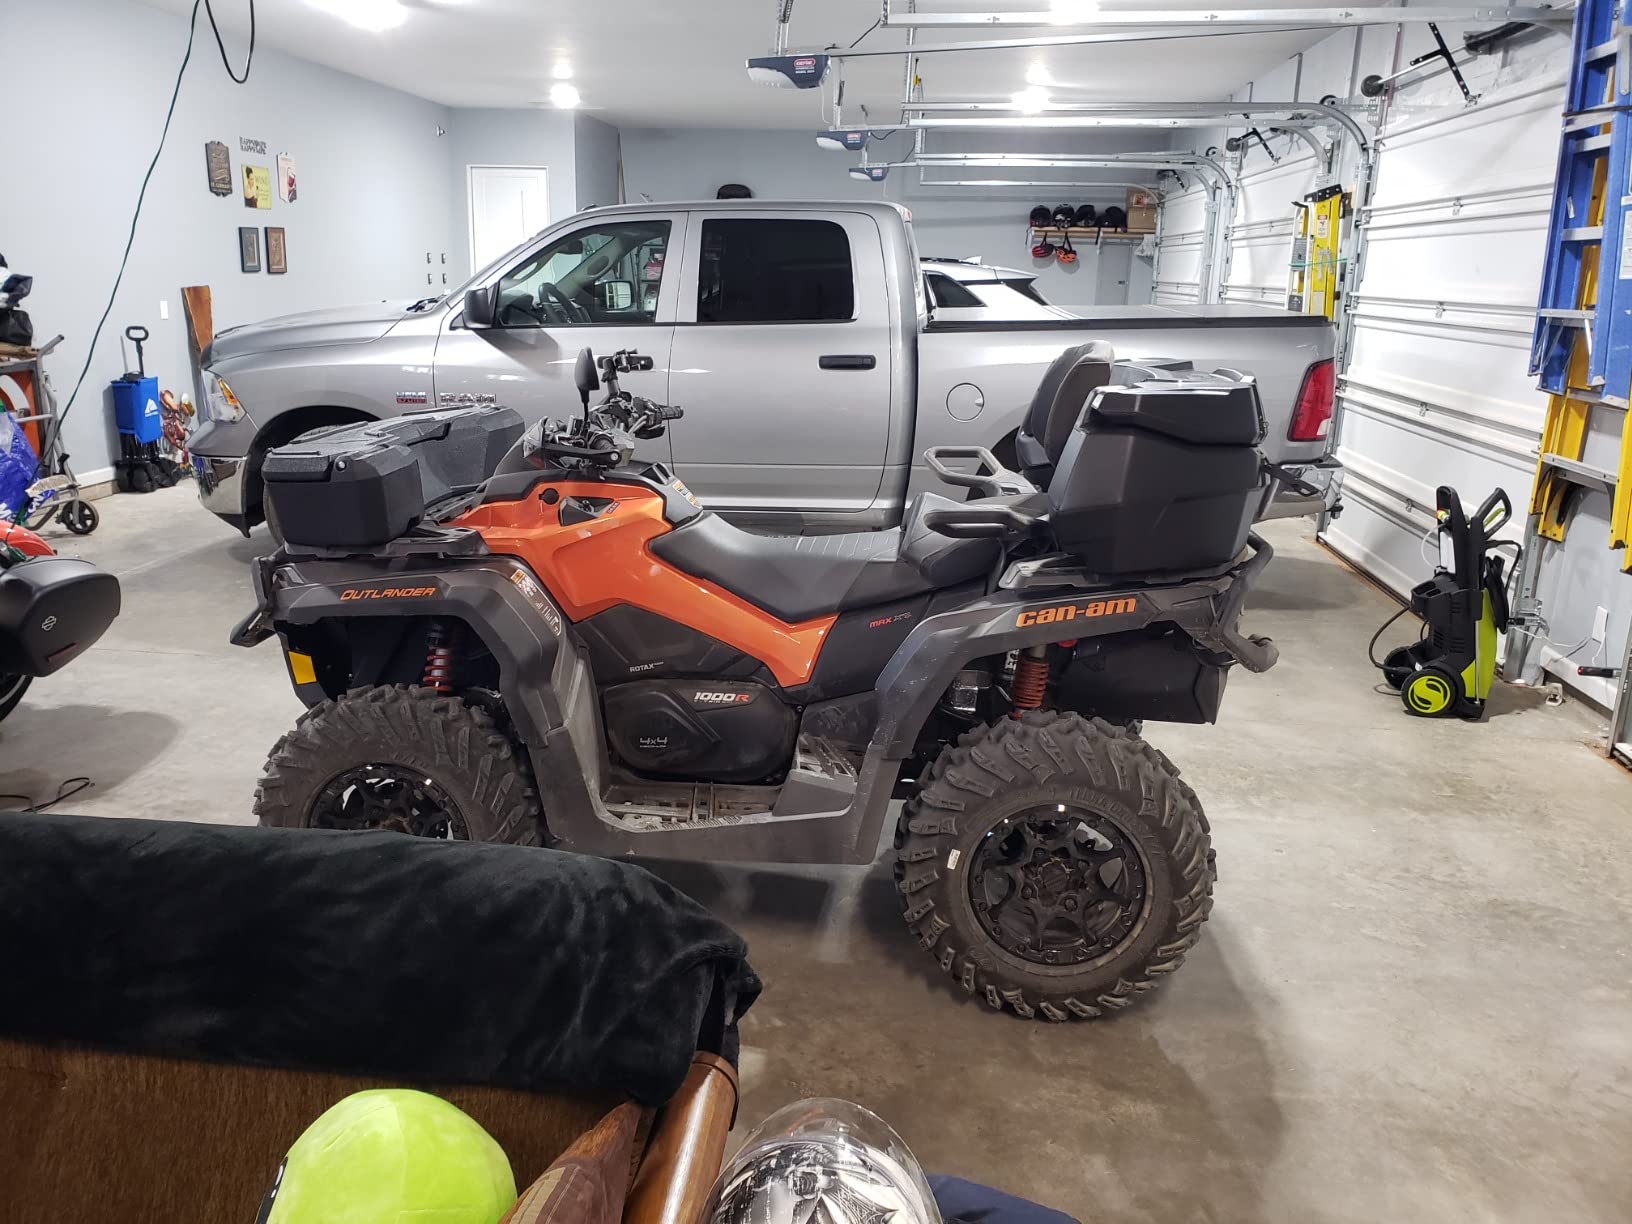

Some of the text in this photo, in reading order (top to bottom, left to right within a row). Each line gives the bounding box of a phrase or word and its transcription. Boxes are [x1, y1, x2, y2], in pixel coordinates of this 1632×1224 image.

[340, 587, 437, 600] OUTLANDER
[1015, 598, 1137, 627] can-am
[869, 617, 893, 628] MAX
[629, 663, 655, 673] ROTAX
[693, 691, 750, 703] 1000R
[639, 736, 668, 745] 4x4
